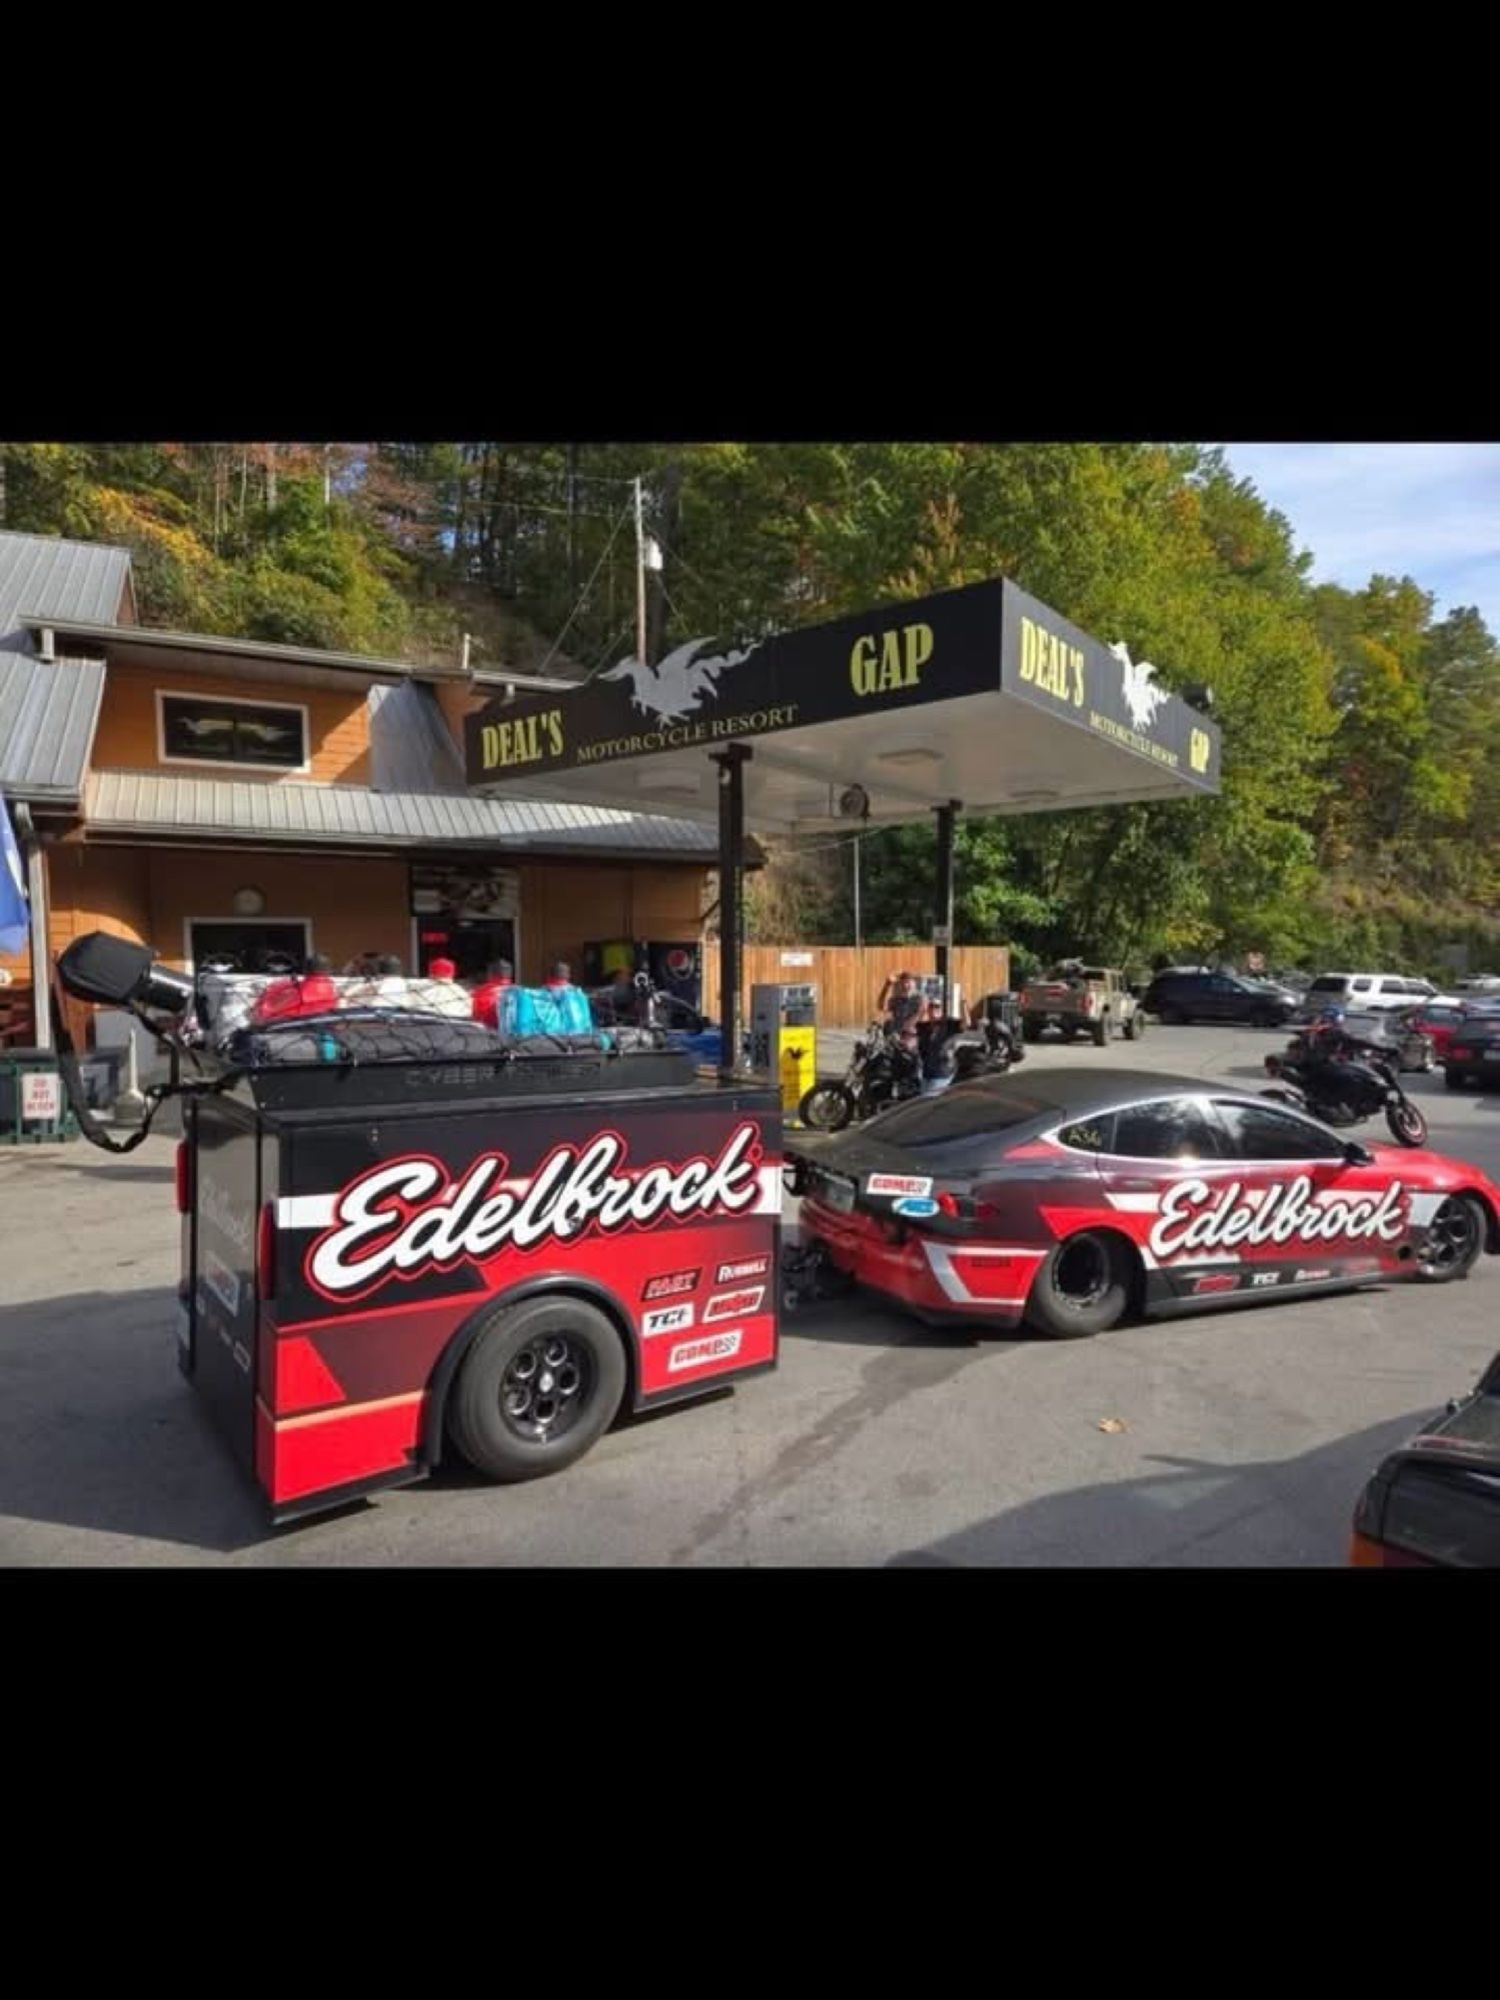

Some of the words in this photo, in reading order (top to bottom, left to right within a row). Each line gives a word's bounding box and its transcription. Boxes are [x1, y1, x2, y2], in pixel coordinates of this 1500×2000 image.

[850, 623, 934, 696] GAP
[1019, 616, 1084, 708] DEAL'S
[481, 709, 564, 769] DEAL'S
[576, 724, 706, 763] MOTORCYCLE
[712, 703, 798, 736] RESORT
[311, 1126, 762, 1290] Edelbrock
[1150, 1175, 1404, 1257] Edelbrock
